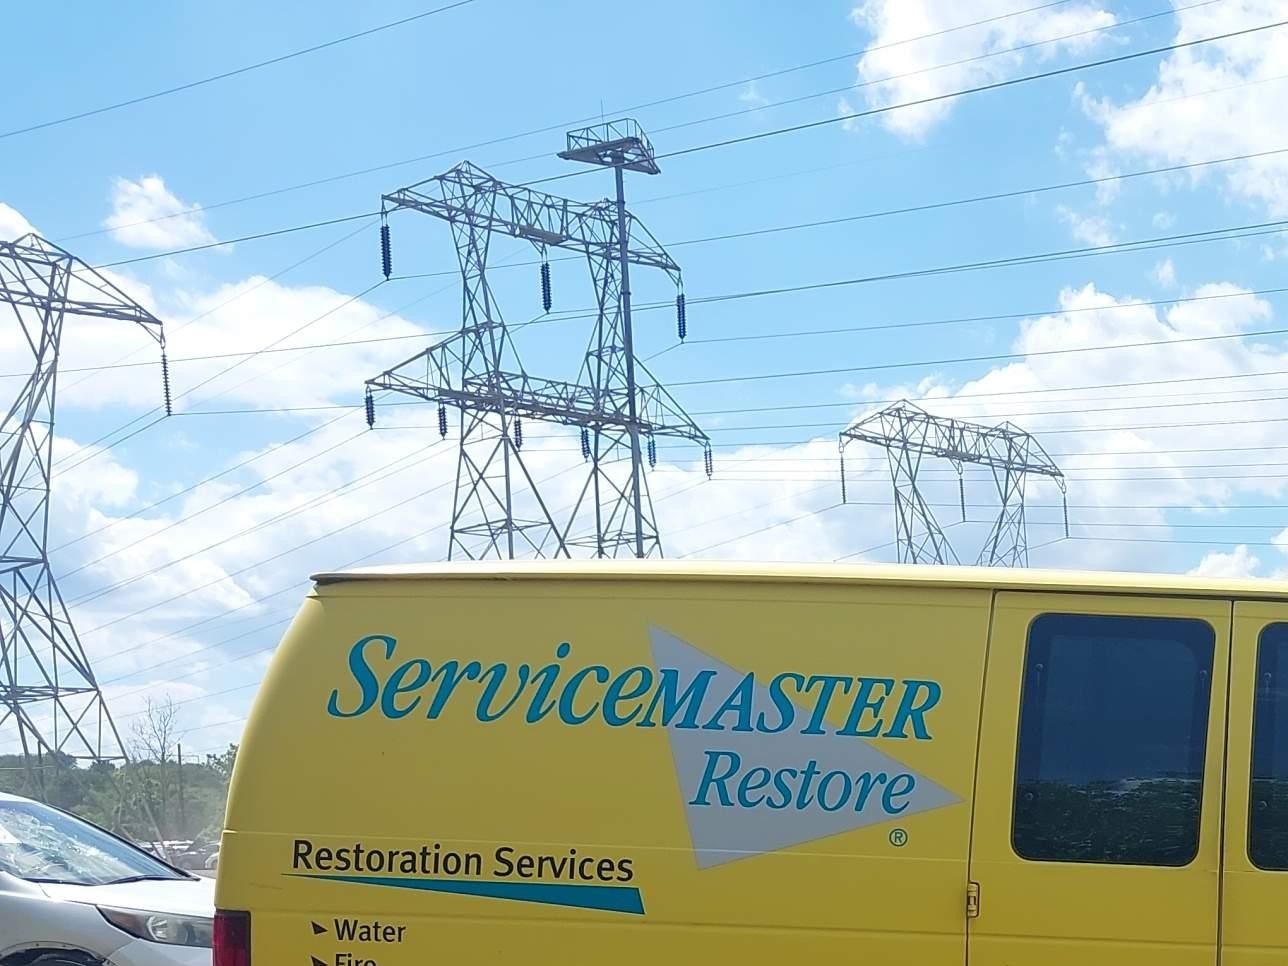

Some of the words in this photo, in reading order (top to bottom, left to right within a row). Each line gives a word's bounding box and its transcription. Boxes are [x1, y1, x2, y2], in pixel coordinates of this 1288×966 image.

[328, 634, 942, 741] ServiceMASTER
[690, 750, 916, 815] Restore
[292, 839, 483, 876] Restoration
[494, 846, 634, 883] Services
[334, 918, 406, 943] Water
